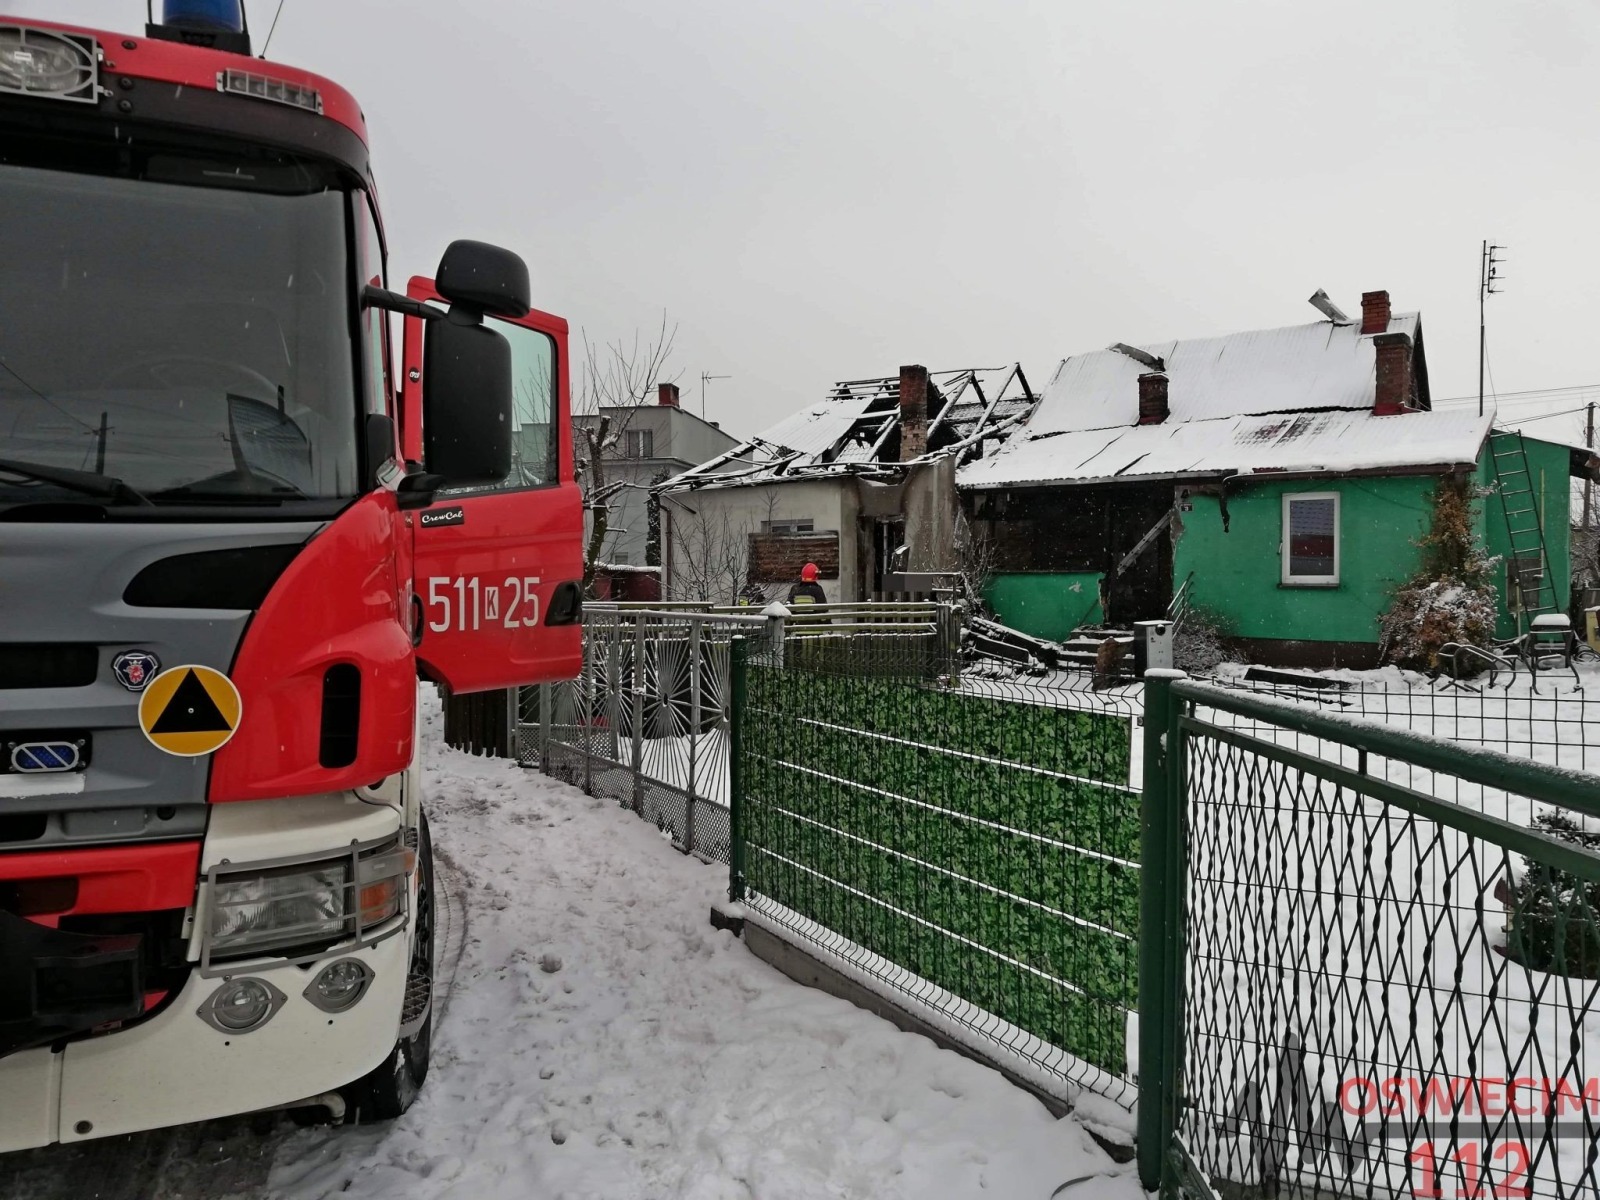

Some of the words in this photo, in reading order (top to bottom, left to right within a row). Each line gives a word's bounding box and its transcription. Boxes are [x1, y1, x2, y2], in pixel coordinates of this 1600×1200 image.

[421, 510, 463, 524] CrewCab
[429, 576, 480, 633] 511
[486, 588, 497, 618] K
[503, 576, 541, 629] 25
